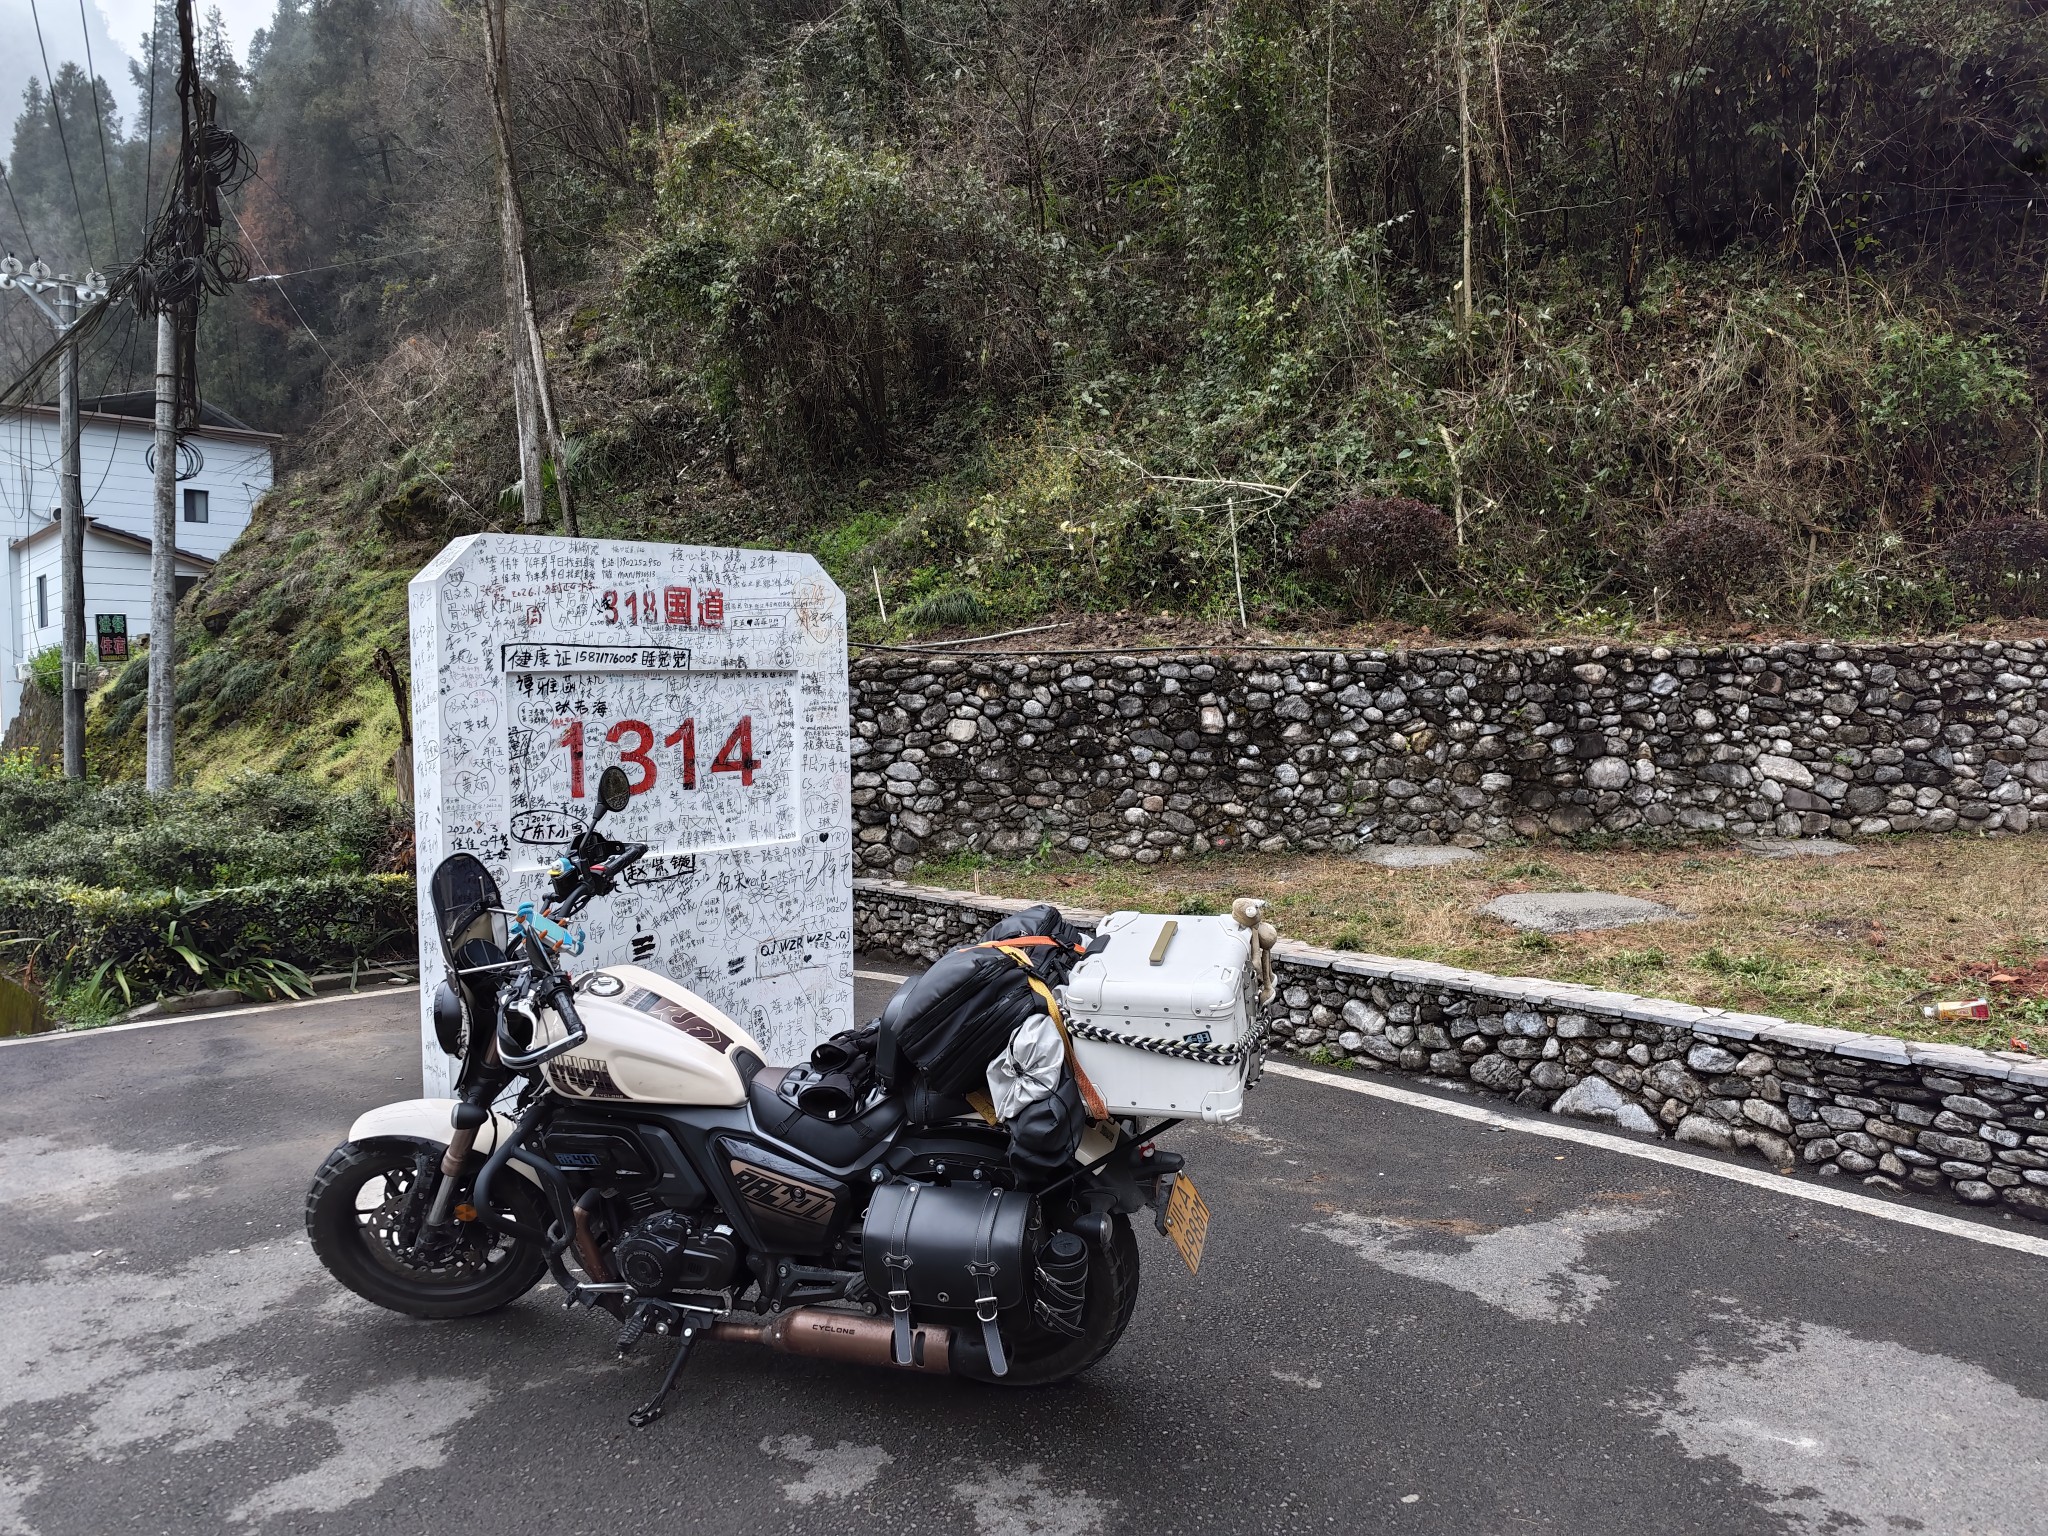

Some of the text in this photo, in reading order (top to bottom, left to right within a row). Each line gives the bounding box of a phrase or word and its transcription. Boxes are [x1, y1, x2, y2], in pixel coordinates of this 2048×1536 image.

[603, 585, 725, 628] 318国道
[101, 636, 126, 654] 住宿
[561, 713, 762, 798] 1314
[812, 1324, 856, 1335] CYCLONE
